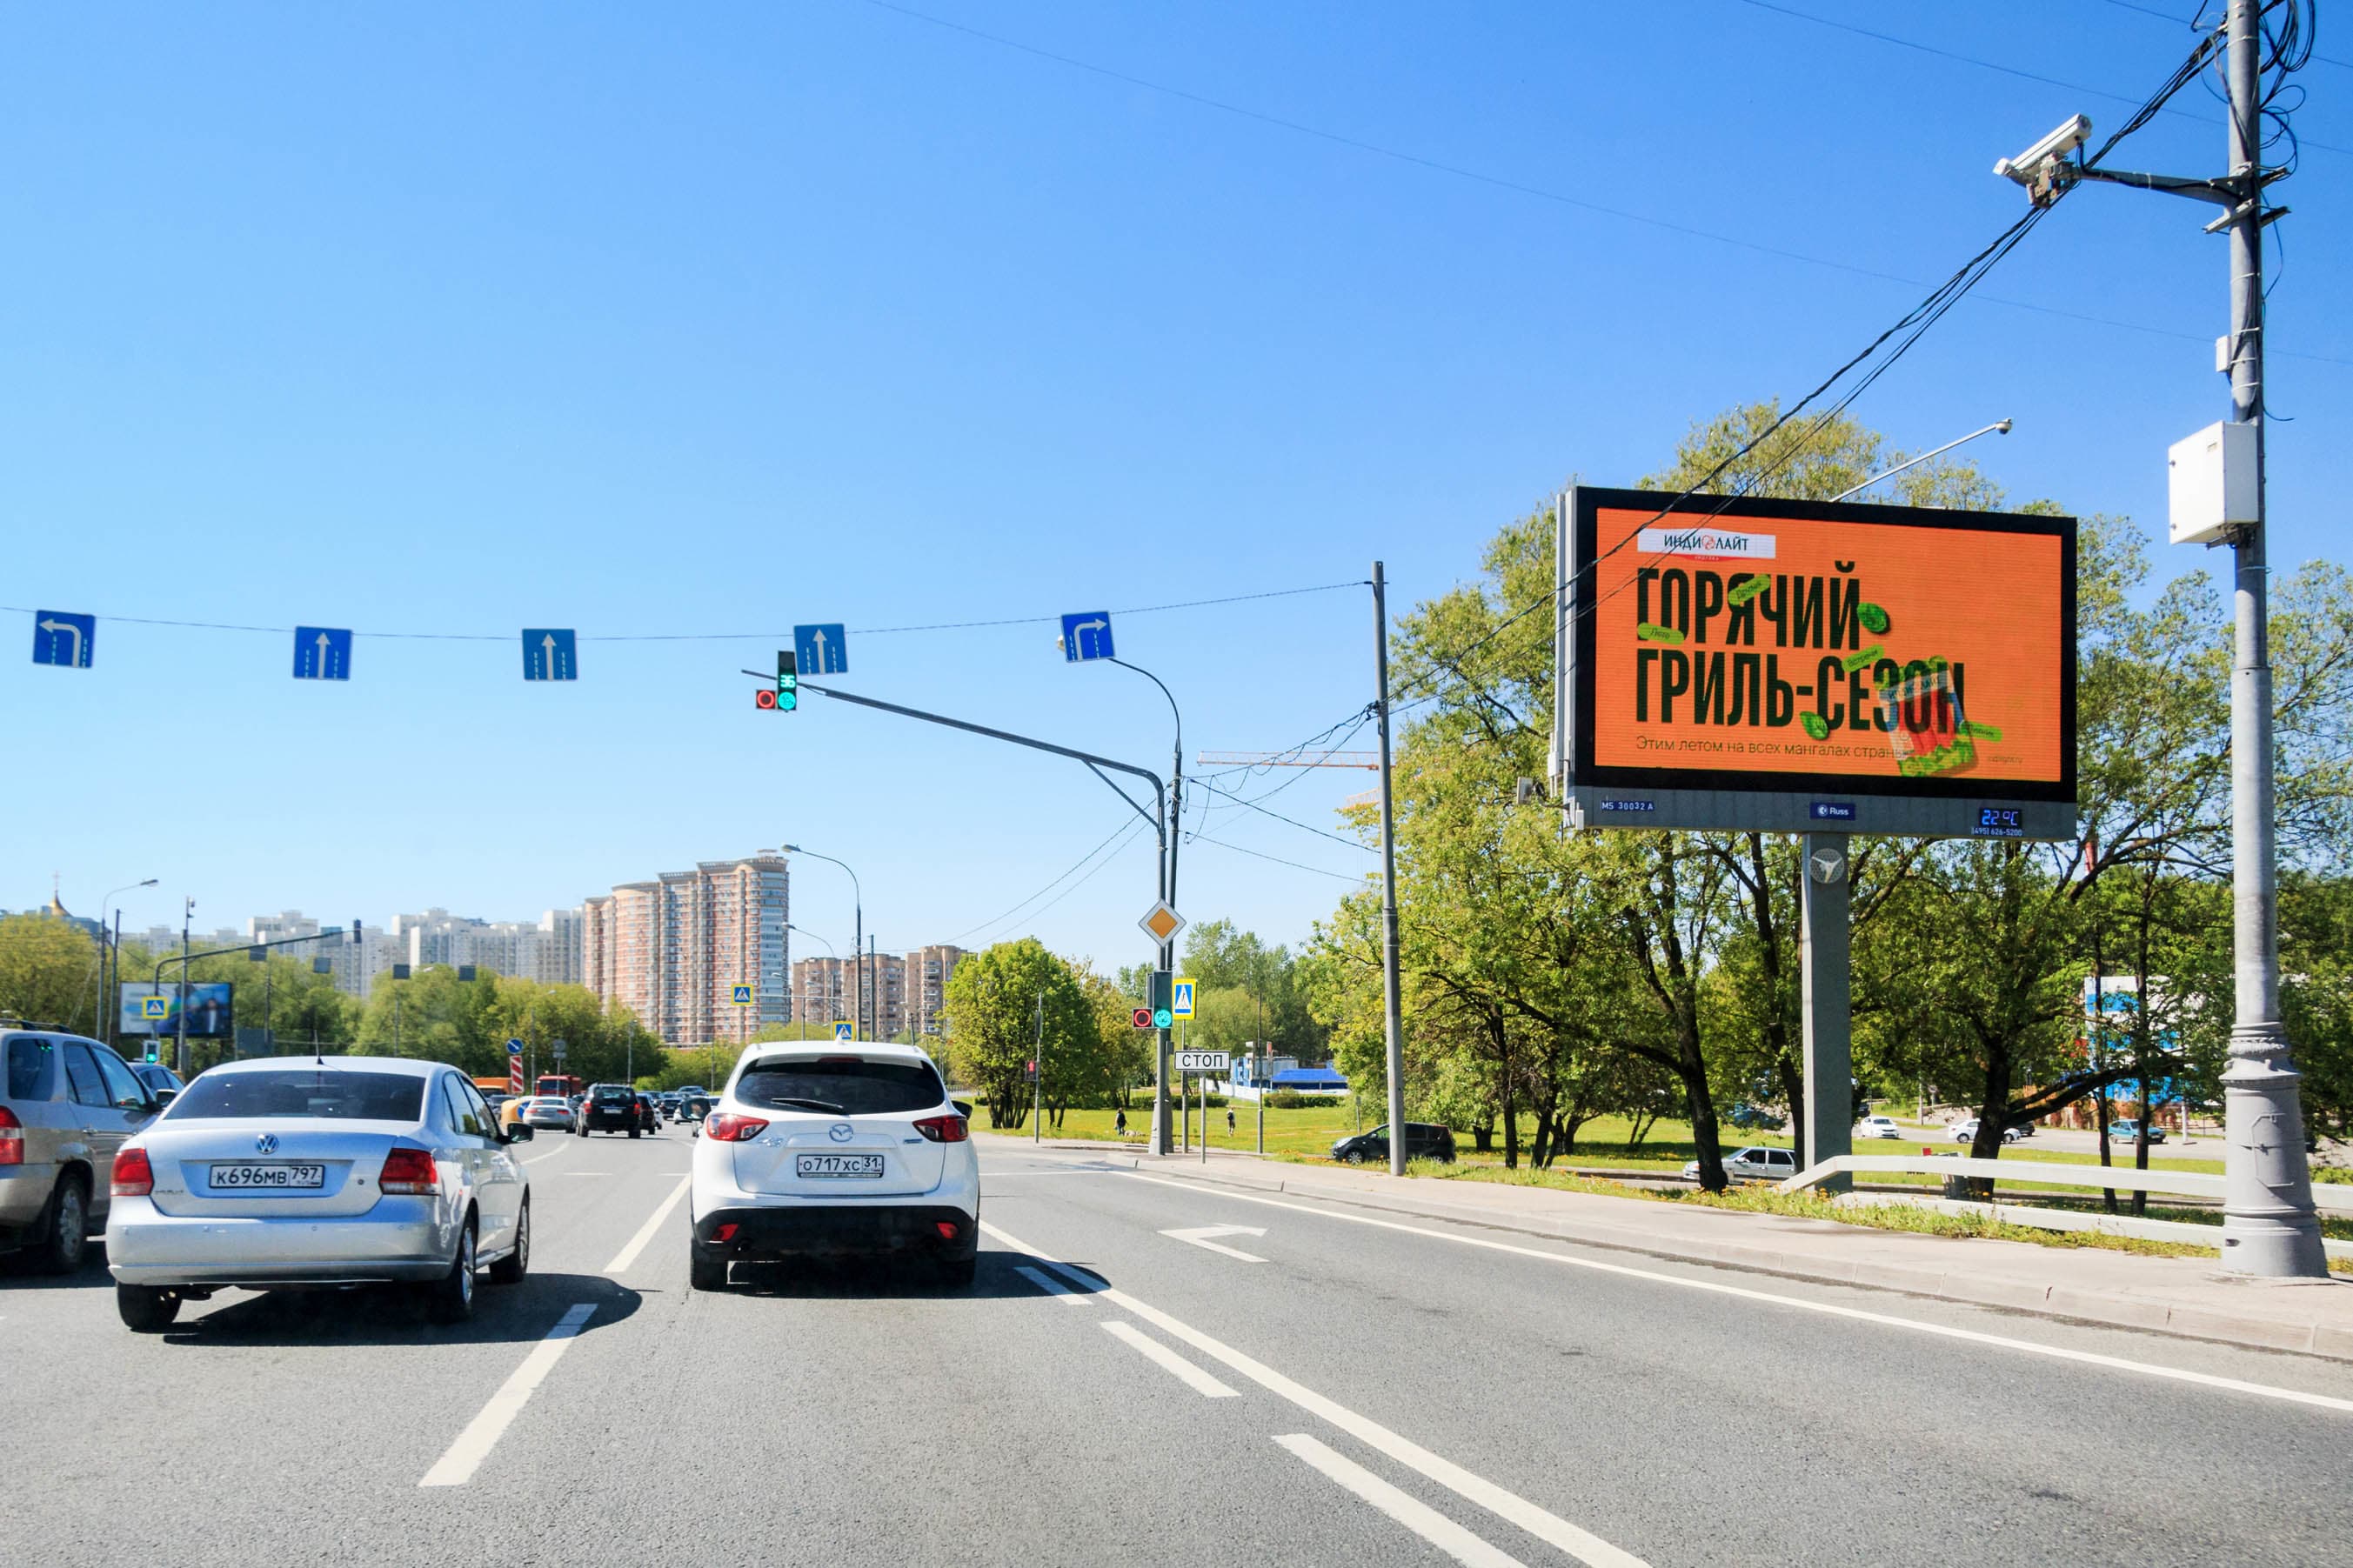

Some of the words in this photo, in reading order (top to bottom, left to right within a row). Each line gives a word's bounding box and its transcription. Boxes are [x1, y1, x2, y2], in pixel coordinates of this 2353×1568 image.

[1637, 560, 1860, 651] ГОРЯЧИЙ
[1636, 648, 1965, 736] ГРИЛЬ-СЕЗОН
[1636, 735, 1675, 751] Этим
[1678, 739, 1723, 752] летом
[1727, 743, 1744, 753] на
[1748, 742, 1781, 754] всех
[1784, 744, 1850, 757] мангалах
[1618, 801, 1645, 811] 30032
[1829, 806, 1849, 816] Russ
[1182, 1054, 1223, 1068] СТОП
[291, 1167, 318, 1180] 797
